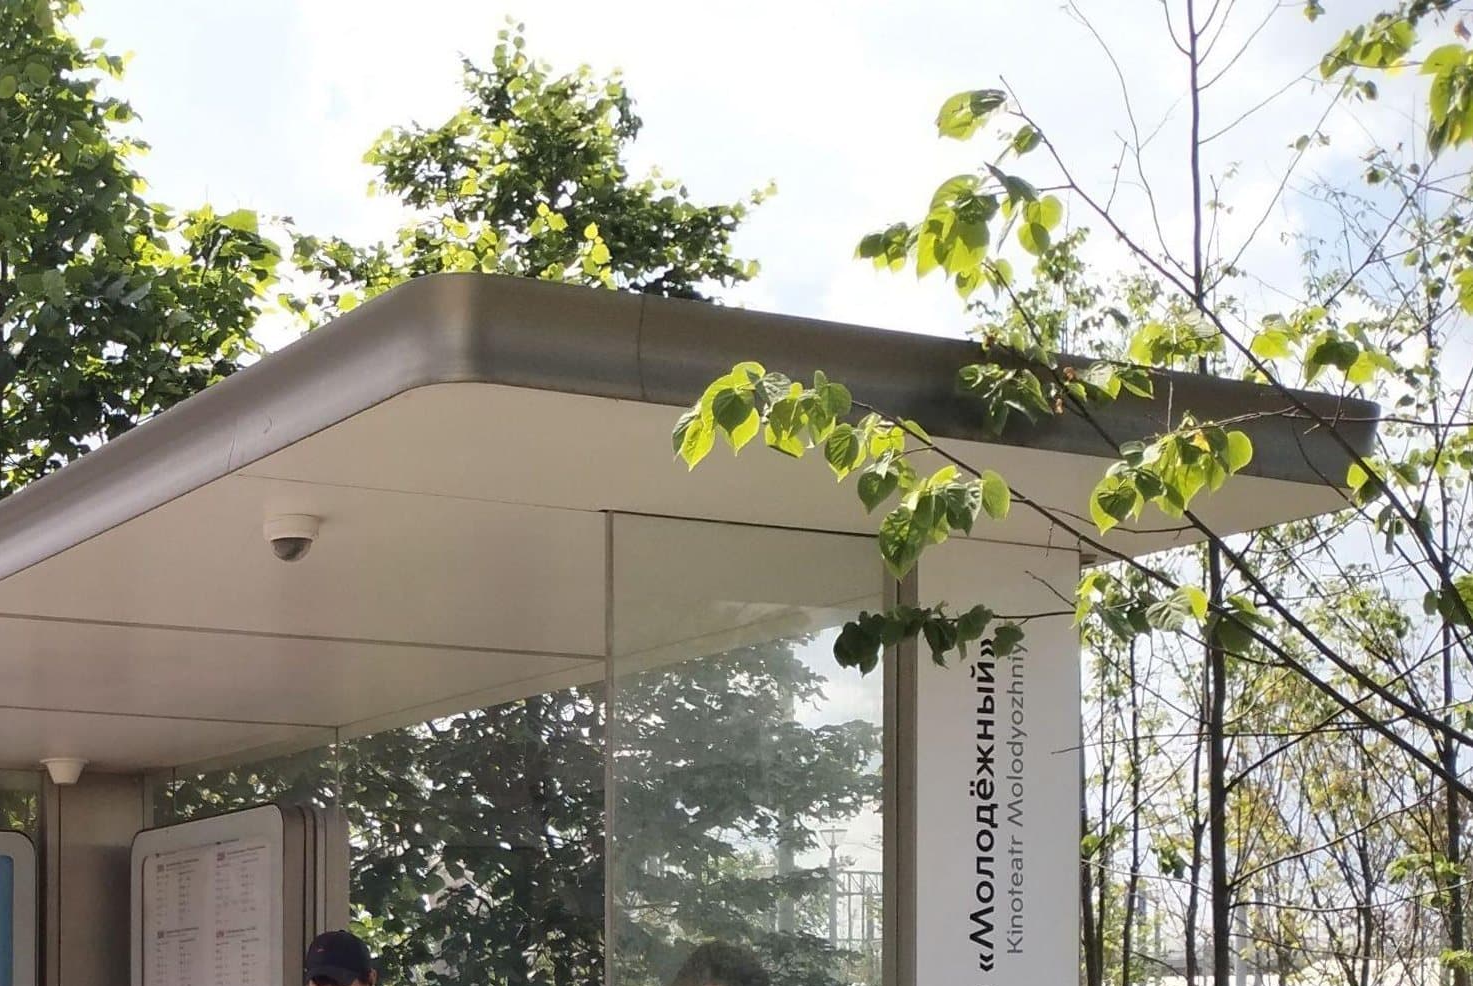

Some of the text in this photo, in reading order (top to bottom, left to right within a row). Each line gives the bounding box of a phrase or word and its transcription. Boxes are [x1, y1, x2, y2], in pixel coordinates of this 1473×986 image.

[969, 638, 999, 973] «Молодёжный»
[1007, 642, 1028, 954] Kinoteatr Molodyozhniy
